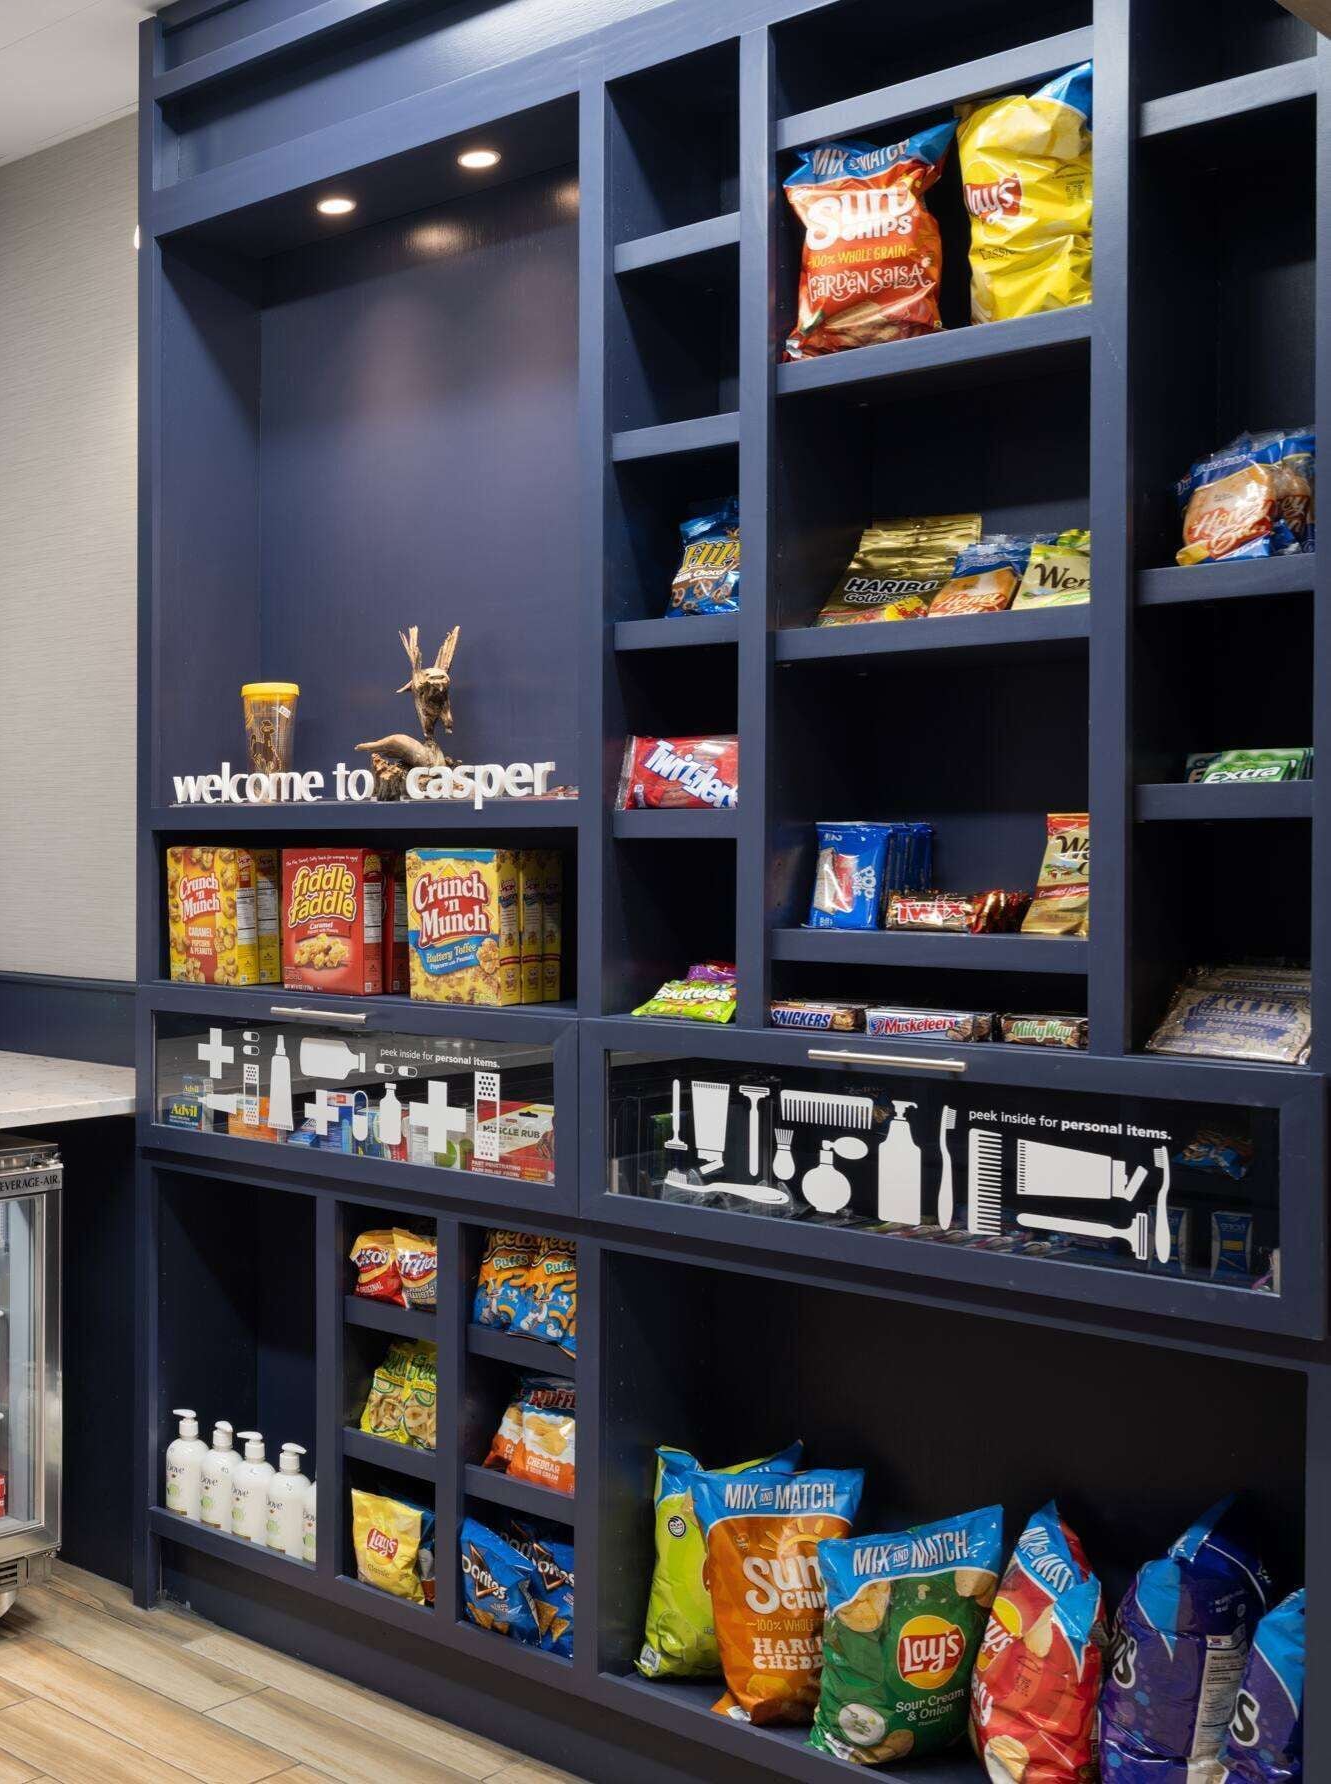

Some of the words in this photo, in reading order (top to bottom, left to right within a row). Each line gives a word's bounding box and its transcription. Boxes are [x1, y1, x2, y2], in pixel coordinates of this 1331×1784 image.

[838, 250, 872, 264] WHOLE
[874, 244, 907, 260] GRAIN
[844, 578, 938, 594] HARIBO
[1204, 765, 1282, 785] Extra
[173, 762, 324, 804] welcome
[332, 762, 375, 801] to
[406, 761, 556, 810] casper
[180, 873, 219, 901] Crunch
[293, 864, 354, 897] fiddle
[415, 872, 486, 912] Crunch
[183, 893, 221, 921] Munch
[289, 890, 355, 927] faddle
[188, 927, 213, 938] CARAMEL
[421, 905, 488, 945] Munch
[772, 1009, 831, 1029] SNICKERS
[884, 1017, 956, 1034] Musketeers
[1014, 1022, 1045, 1040] Milky
[1045, 1022, 1072, 1040] Way
[380, 1048, 398, 1059] peek
[400, 1049, 421, 1060] inside
[422, 1052, 434, 1062] for
[435, 1054, 472, 1067] personal
[473, 1057, 501, 1069] items.
[183, 1084, 199, 1094] Advil
[170, 1104, 198, 1118] Advil
[520, 1129, 541, 1139] RUB
[969, 1110, 998, 1122] peek
[1000, 1111, 1037, 1127] inside
[1038, 1115, 1058, 1128] for
[1061, 1119, 1123, 1135] personal
[1126, 1124, 1173, 1141] items.
[493, 1255, 528, 1271] Puffs
[526, 1455, 561, 1473] CHEDDAR
[201, 1472, 218, 1486] Dove
[725, 1484, 757, 1509] MIX
[774, 1484, 835, 1510] MATCH
[302, 1509, 315, 1521] Dov
[369, 1529, 397, 1557] Lay's
[853, 1543, 890, 1577] MIX
[893, 1549, 909, 1563] AND
[911, 1528, 969, 1569] MATCH
[462, 1554, 508, 1600] Doritos
[742, 1554, 822, 1615] Sun
[757, 1619, 782, 1632] 100%
[753, 1654, 823, 1671] CHEDD
[903, 1631, 960, 1674] Lay's
[895, 1699, 926, 1714] Sour
[927, 1687, 965, 1707] Cream
[906, 1711, 918, 1722] &
[920, 1704, 953, 1720] Onion
